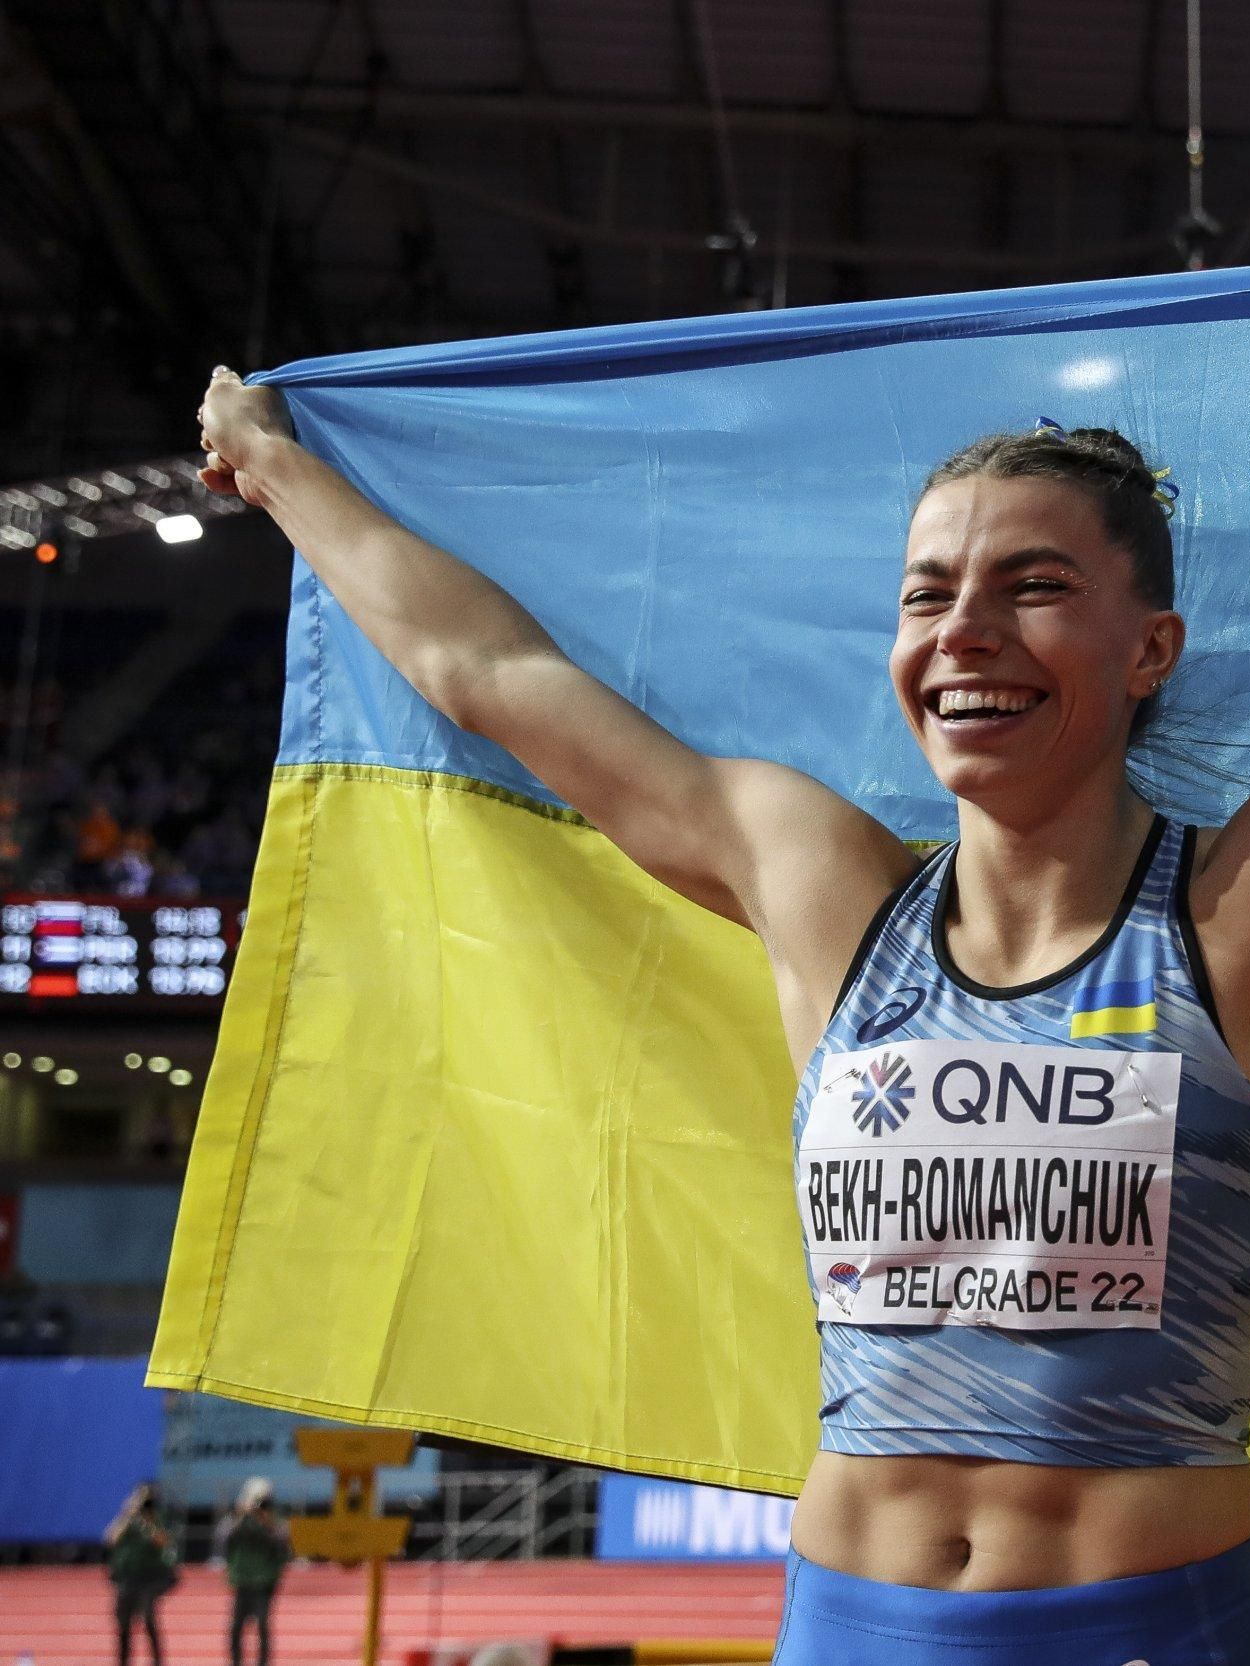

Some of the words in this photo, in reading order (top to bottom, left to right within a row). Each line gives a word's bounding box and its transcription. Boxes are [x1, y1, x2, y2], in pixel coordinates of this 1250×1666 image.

[932, 1058, 1116, 1126] QNB
[808, 1157, 1158, 1247] BEKH-ROMANCHUK
[883, 1266, 1078, 1314] BELGRADE
[1091, 1272, 1146, 1313] 22
